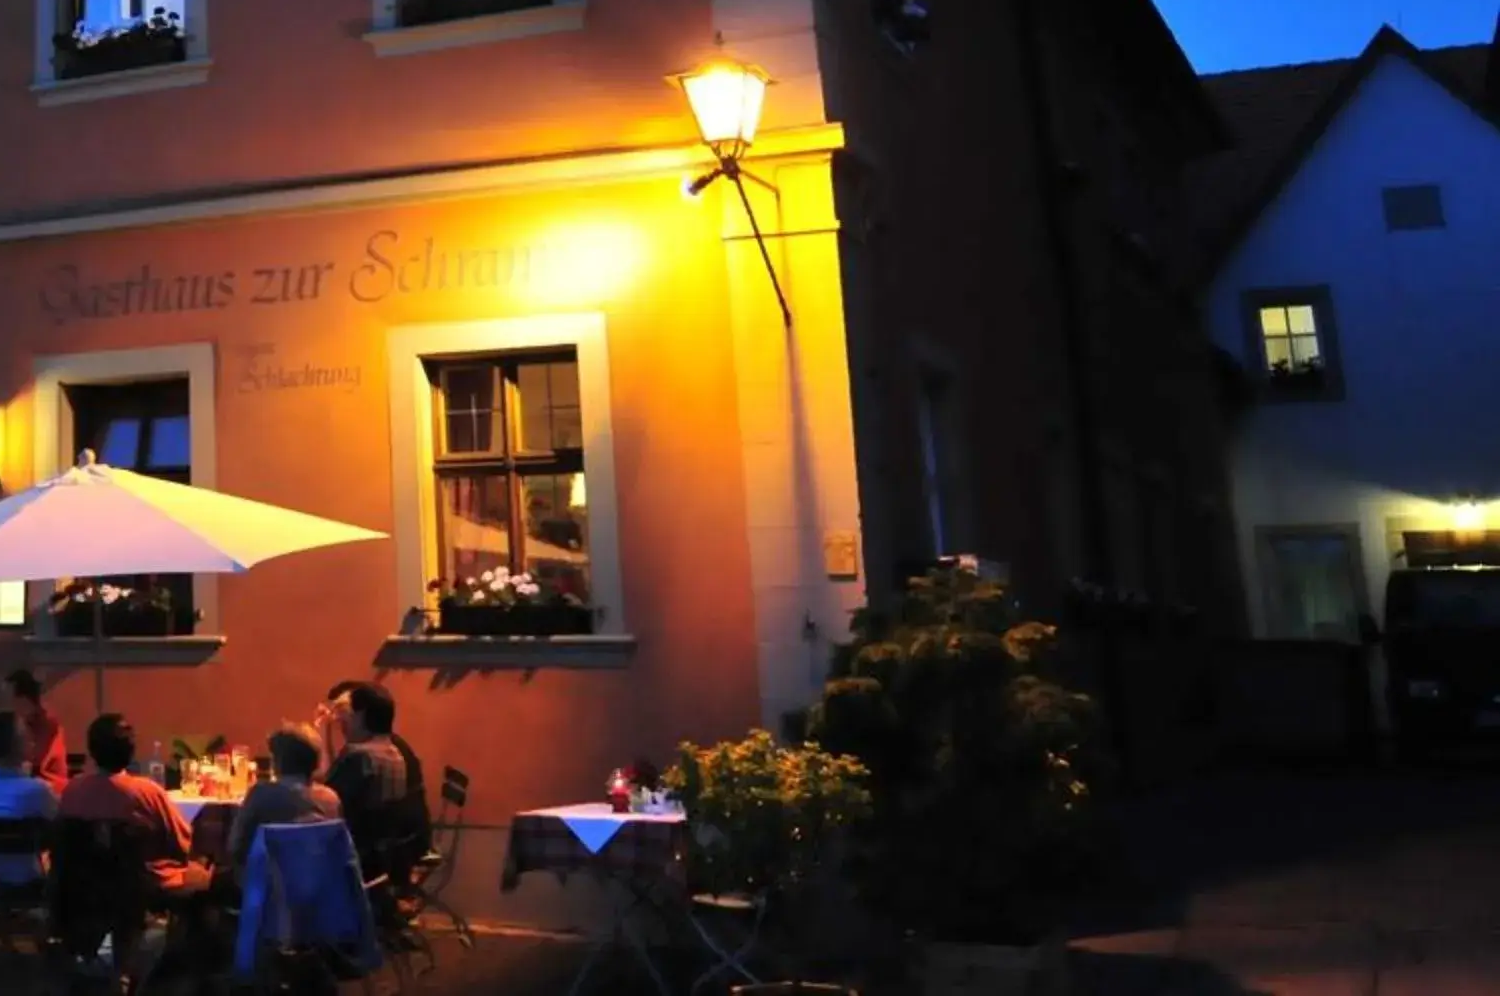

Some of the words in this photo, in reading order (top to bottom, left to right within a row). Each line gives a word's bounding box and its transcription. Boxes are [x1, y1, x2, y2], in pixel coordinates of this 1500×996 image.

[36, 261, 235, 327] Gasthaus
[249, 260, 336, 305] zur
[348, 228, 546, 303] Schran
